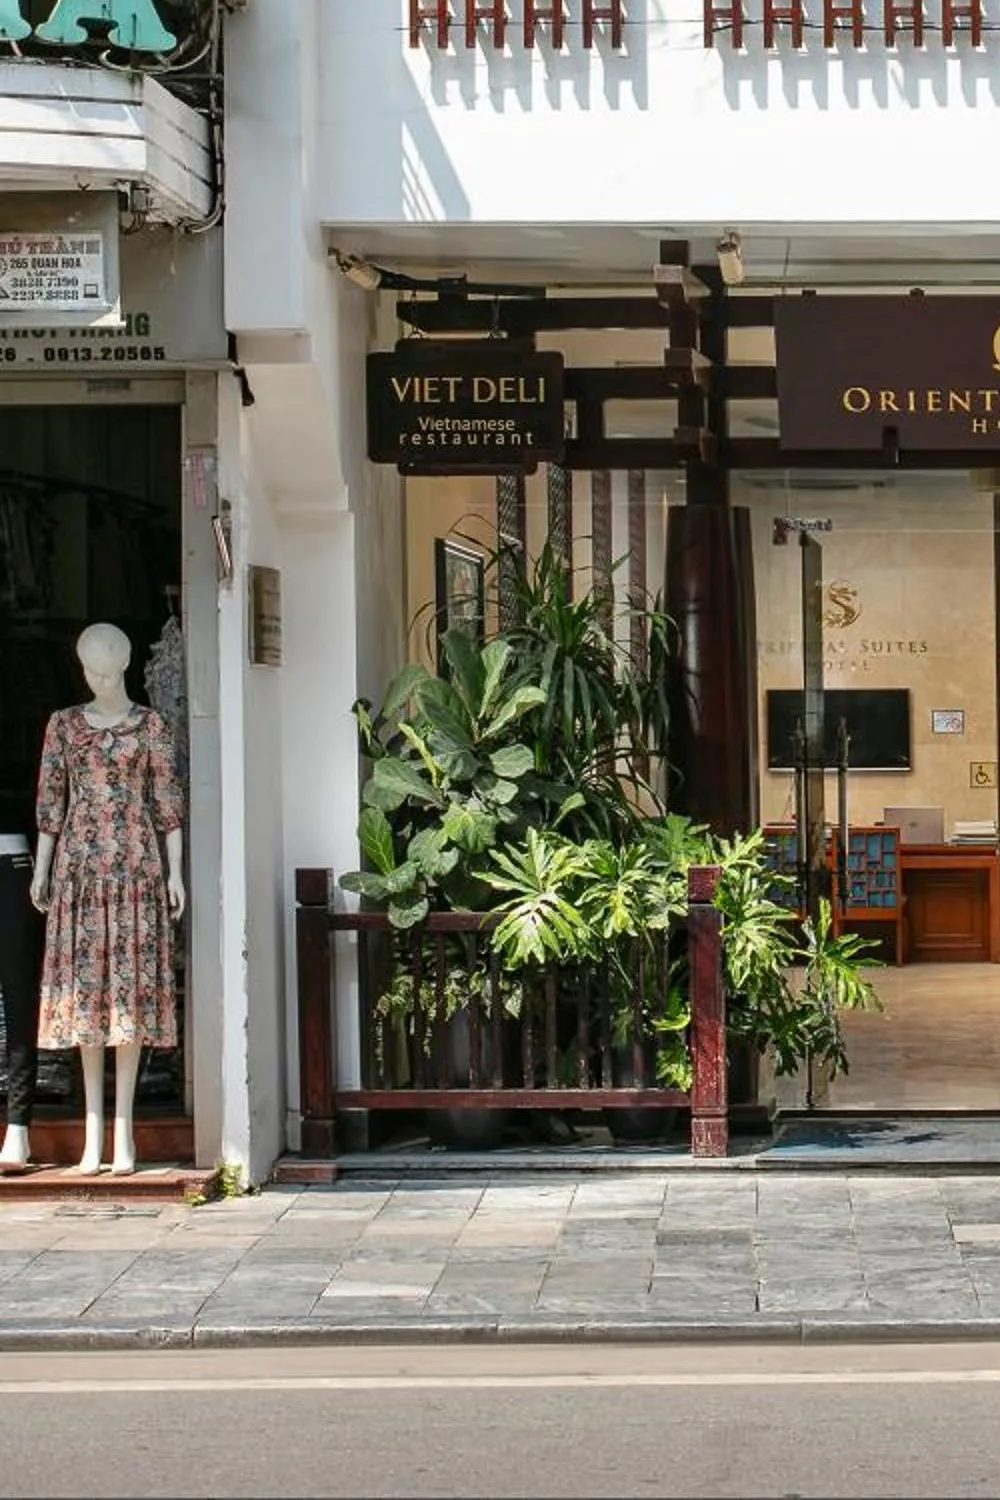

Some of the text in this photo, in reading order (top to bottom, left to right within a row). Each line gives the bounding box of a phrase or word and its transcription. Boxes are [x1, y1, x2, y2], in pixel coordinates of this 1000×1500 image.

[391, 376, 546, 403] VIET DELI
[418, 416, 516, 431] Vietnamese
[399, 431, 534, 446] restaurant
